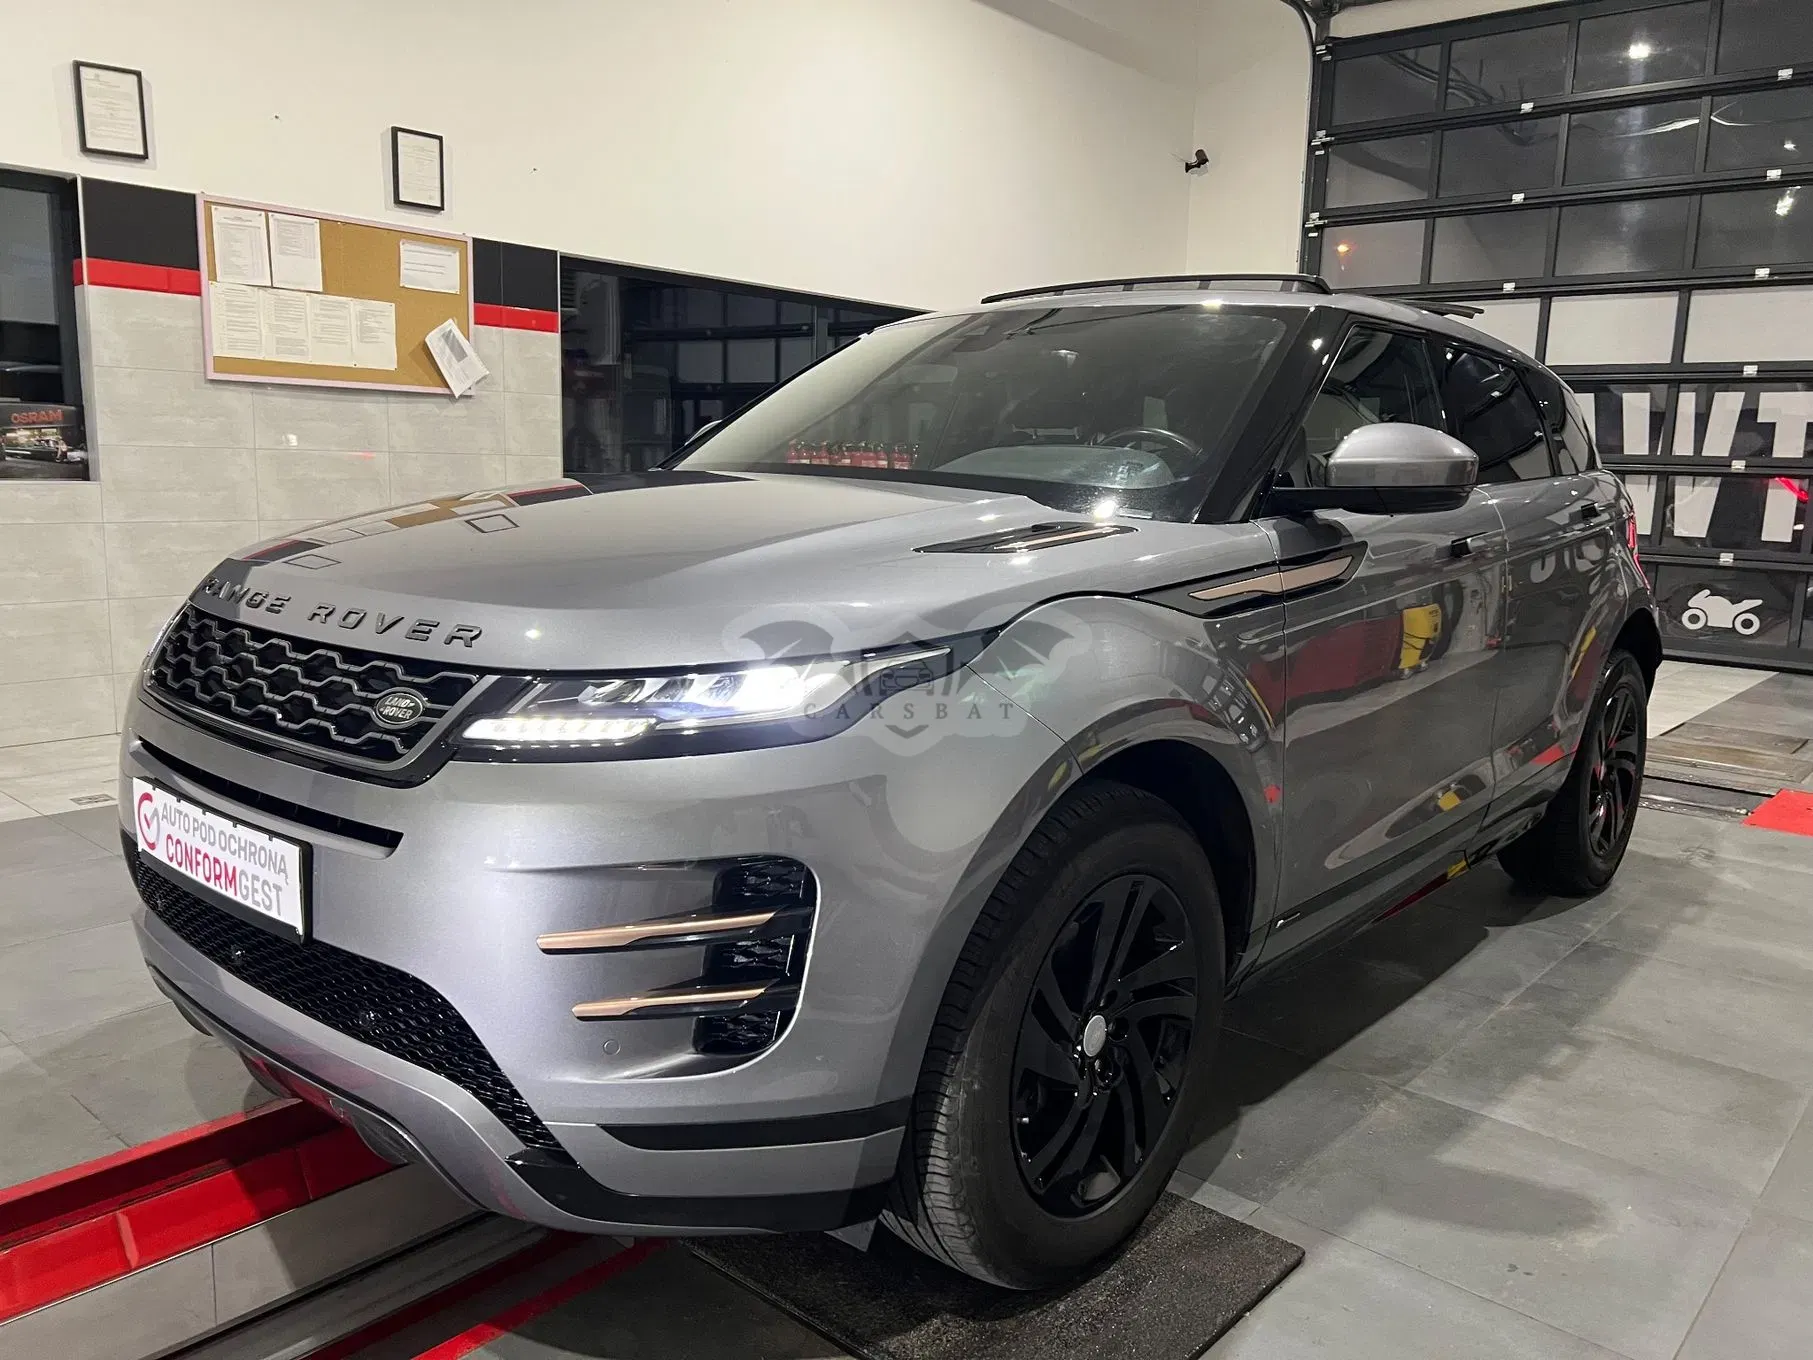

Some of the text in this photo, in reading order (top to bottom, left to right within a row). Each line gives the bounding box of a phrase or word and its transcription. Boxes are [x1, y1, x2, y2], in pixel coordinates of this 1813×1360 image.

[11, 409, 64, 424] OSRAM
[201, 577, 482, 648] RANGE ROVER
[382, 706, 414, 719] ROVER
[384, 696, 412, 708] LAND
[161, 802, 290, 885] AUTO POD OCHRONĄ
[165, 833, 283, 917] CONFORMGEST
